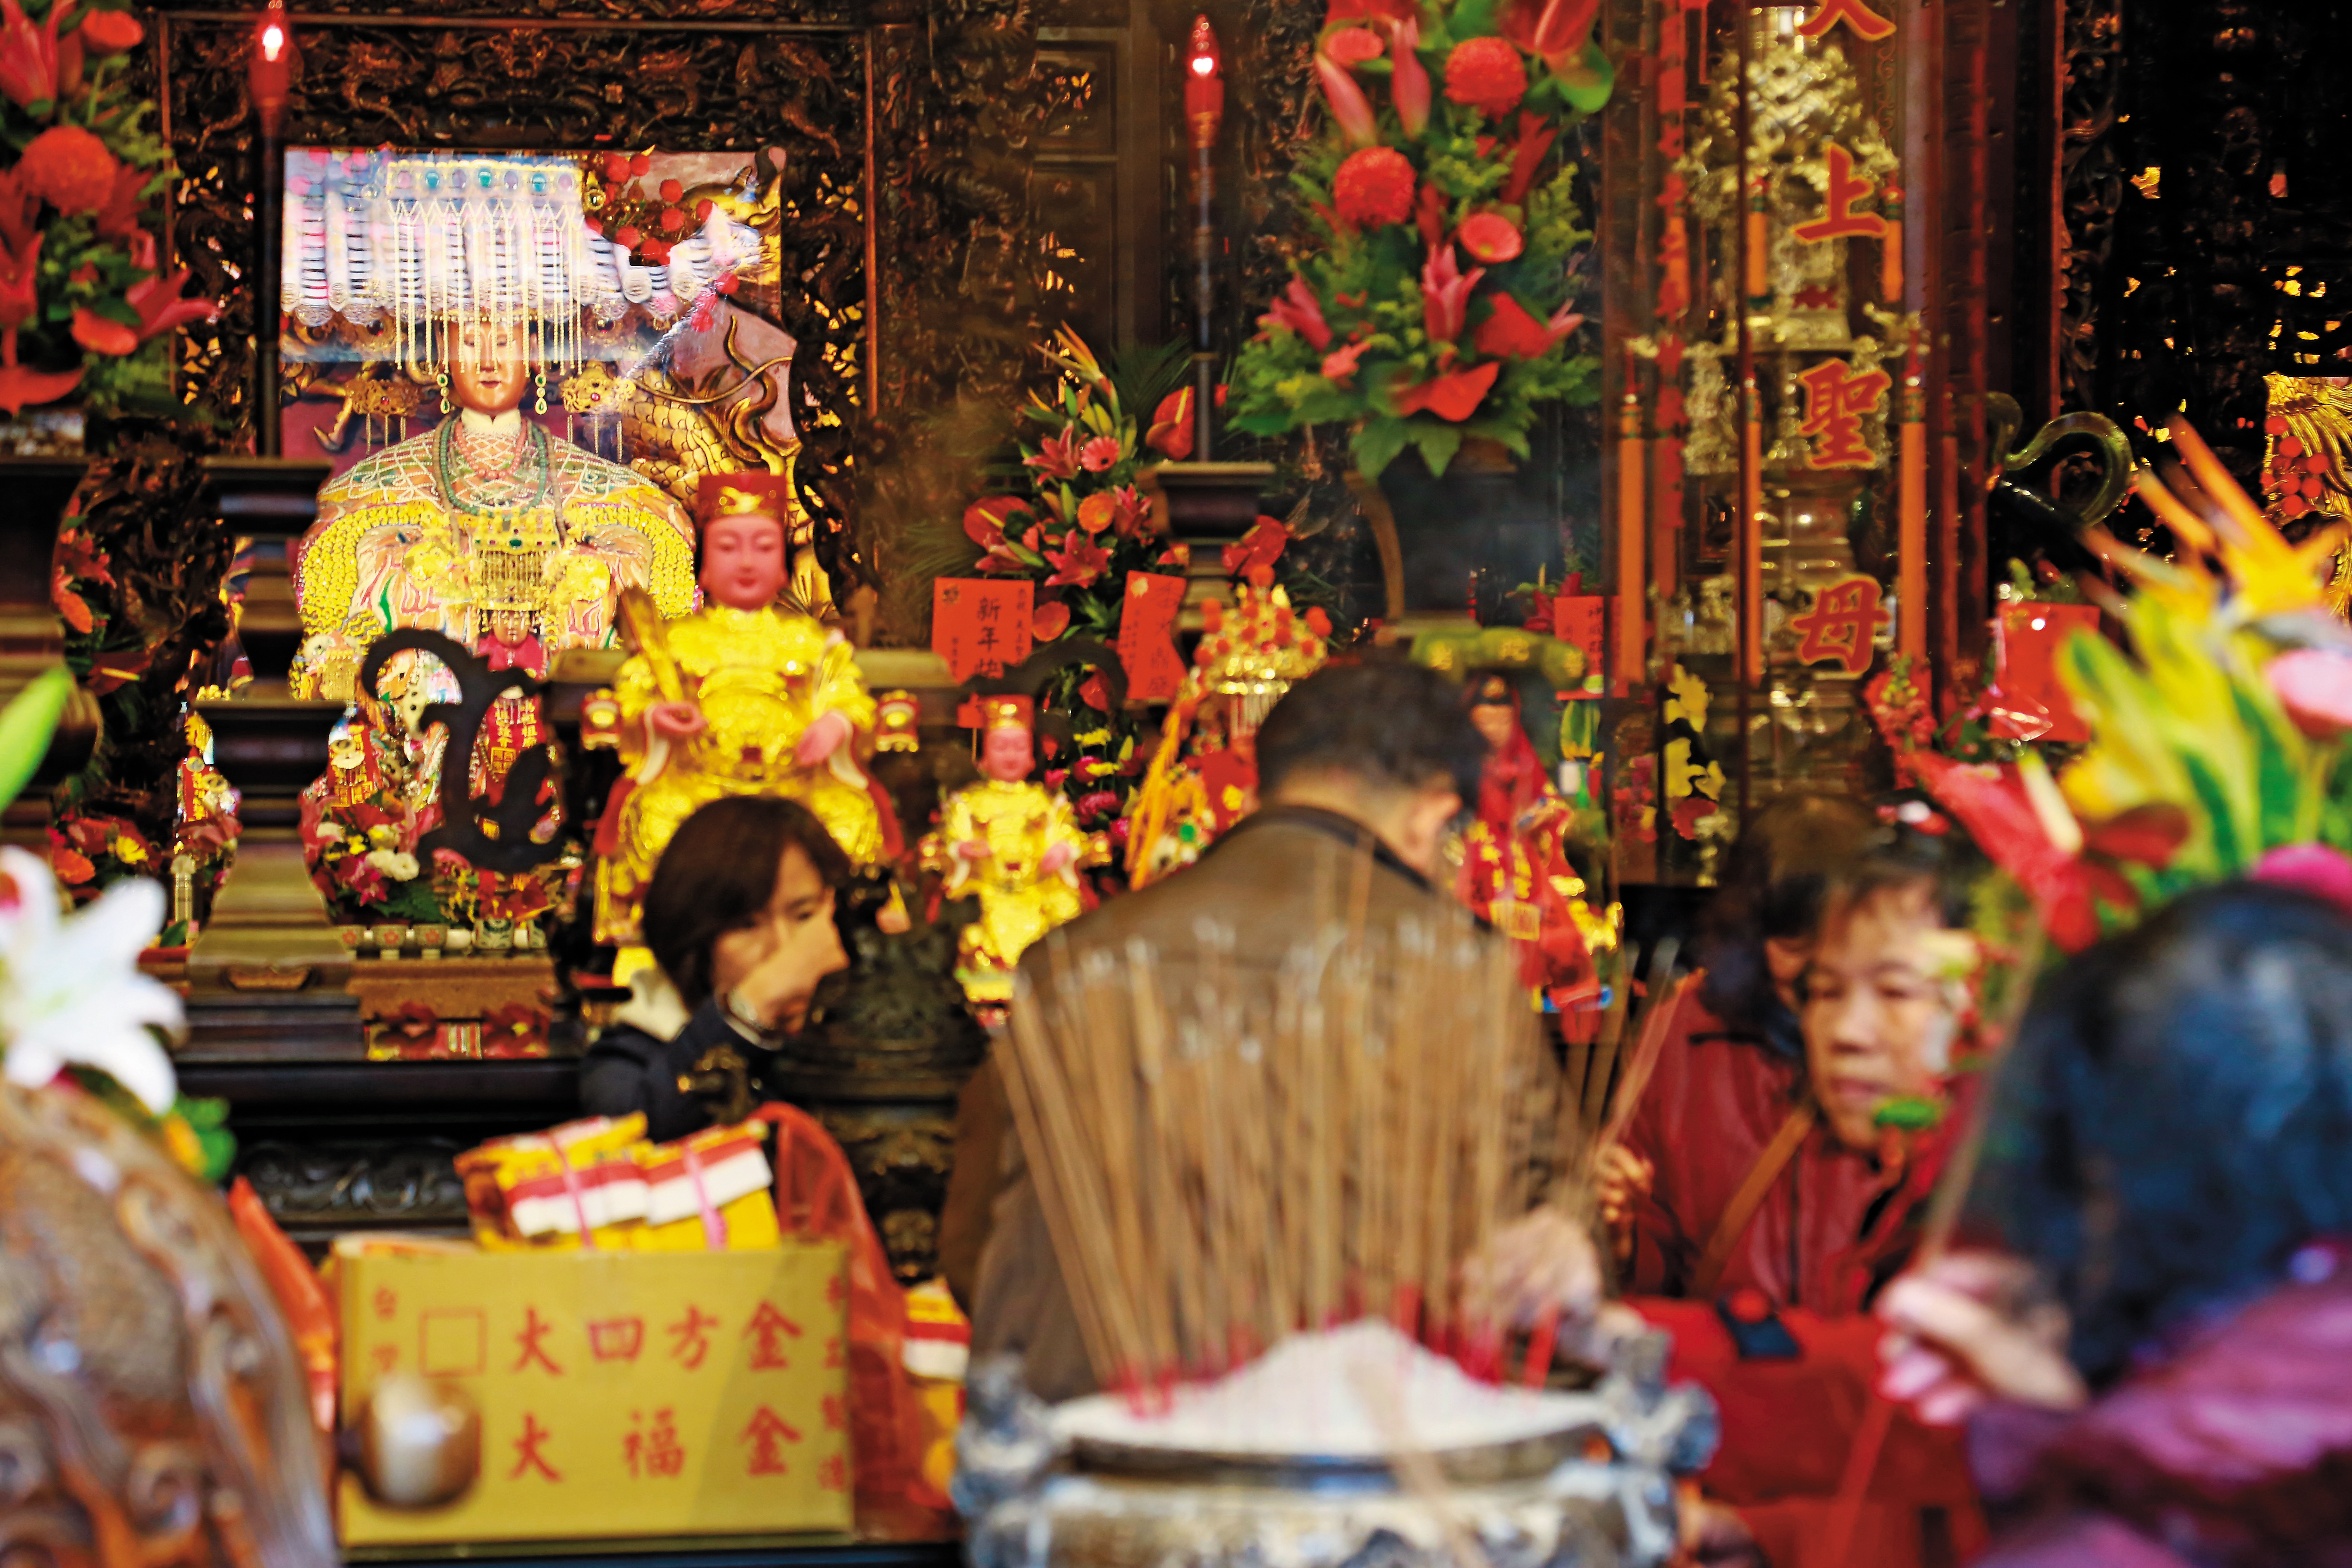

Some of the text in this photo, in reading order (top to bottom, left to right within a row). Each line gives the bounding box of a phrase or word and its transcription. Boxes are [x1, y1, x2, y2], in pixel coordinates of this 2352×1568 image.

[509, 1301, 803, 1376] 大四方金
[508, 1404, 802, 1482] 大福金
